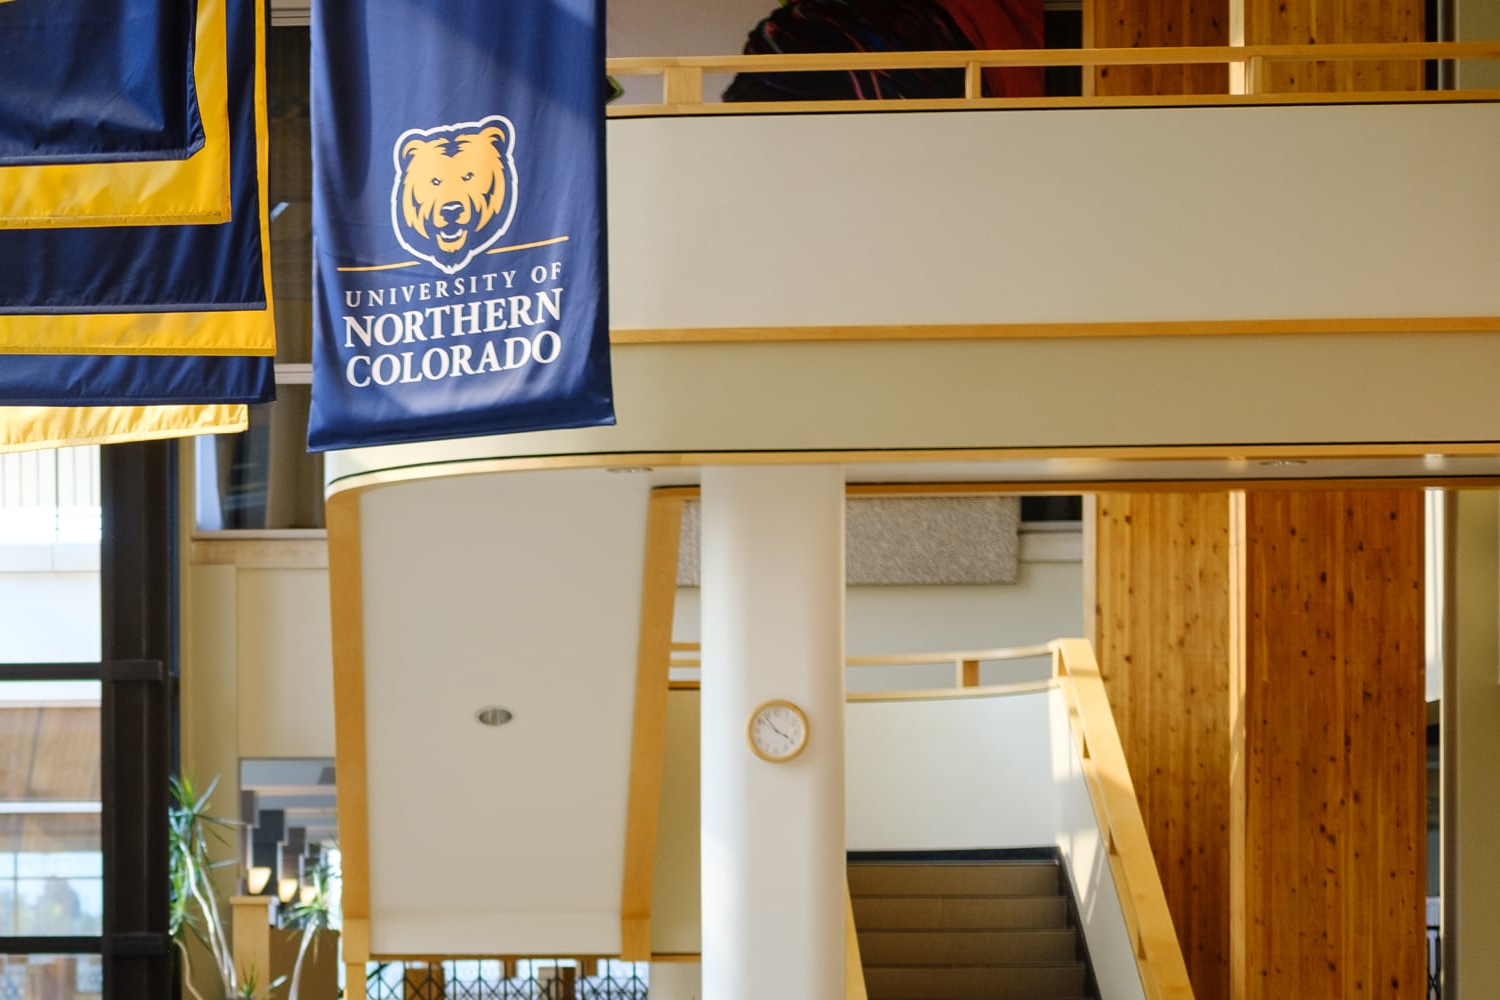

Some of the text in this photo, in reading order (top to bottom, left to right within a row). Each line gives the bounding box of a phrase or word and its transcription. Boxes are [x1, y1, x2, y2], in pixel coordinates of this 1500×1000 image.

[345, 262, 563, 308] UNIVERSITY OF
[342, 288, 564, 348] NORTHERN
[346, 331, 562, 387] COLORADO
